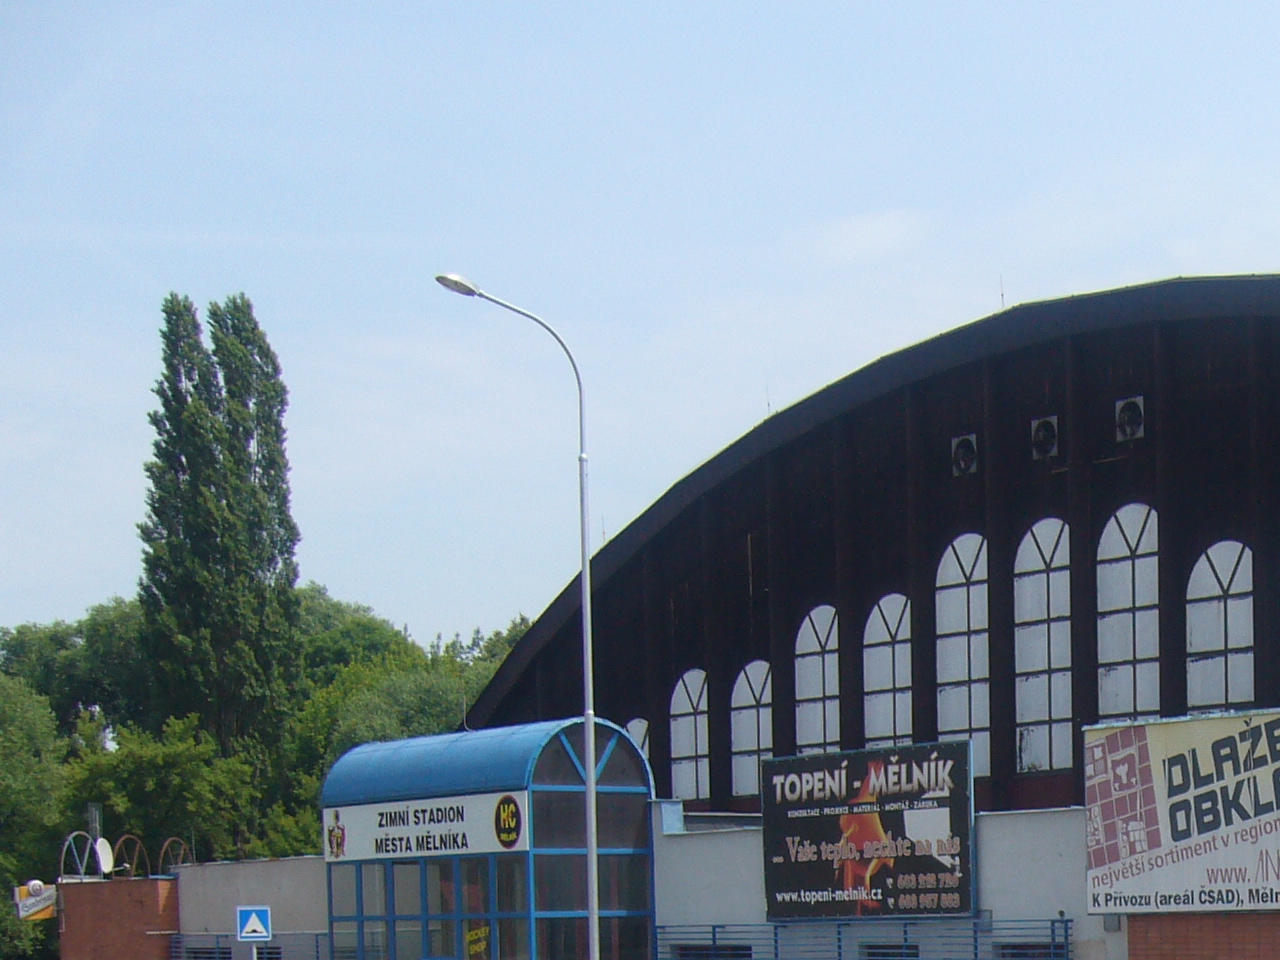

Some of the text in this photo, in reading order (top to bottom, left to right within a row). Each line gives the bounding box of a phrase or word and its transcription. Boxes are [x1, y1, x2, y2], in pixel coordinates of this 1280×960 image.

[772, 759, 849, 804] TOPENÍ
[868, 751, 955, 797] MĚLNÍK
[377, 805, 465, 828] ZIMNÍ STADION
[500, 803, 516, 828] HC
[375, 829, 469, 853] MĚSTA MĚLNÍKA
[786, 836, 818, 863] Vaše
[1092, 855, 1145, 889] největší
[1148, 834, 1219, 871] sortiment
[1221, 834, 1230, 847] v
[775, 886, 883, 904] www.topeni-melnik.cz
[1092, 893, 1101, 908] K
[1104, 891, 1152, 908] Přívozu
